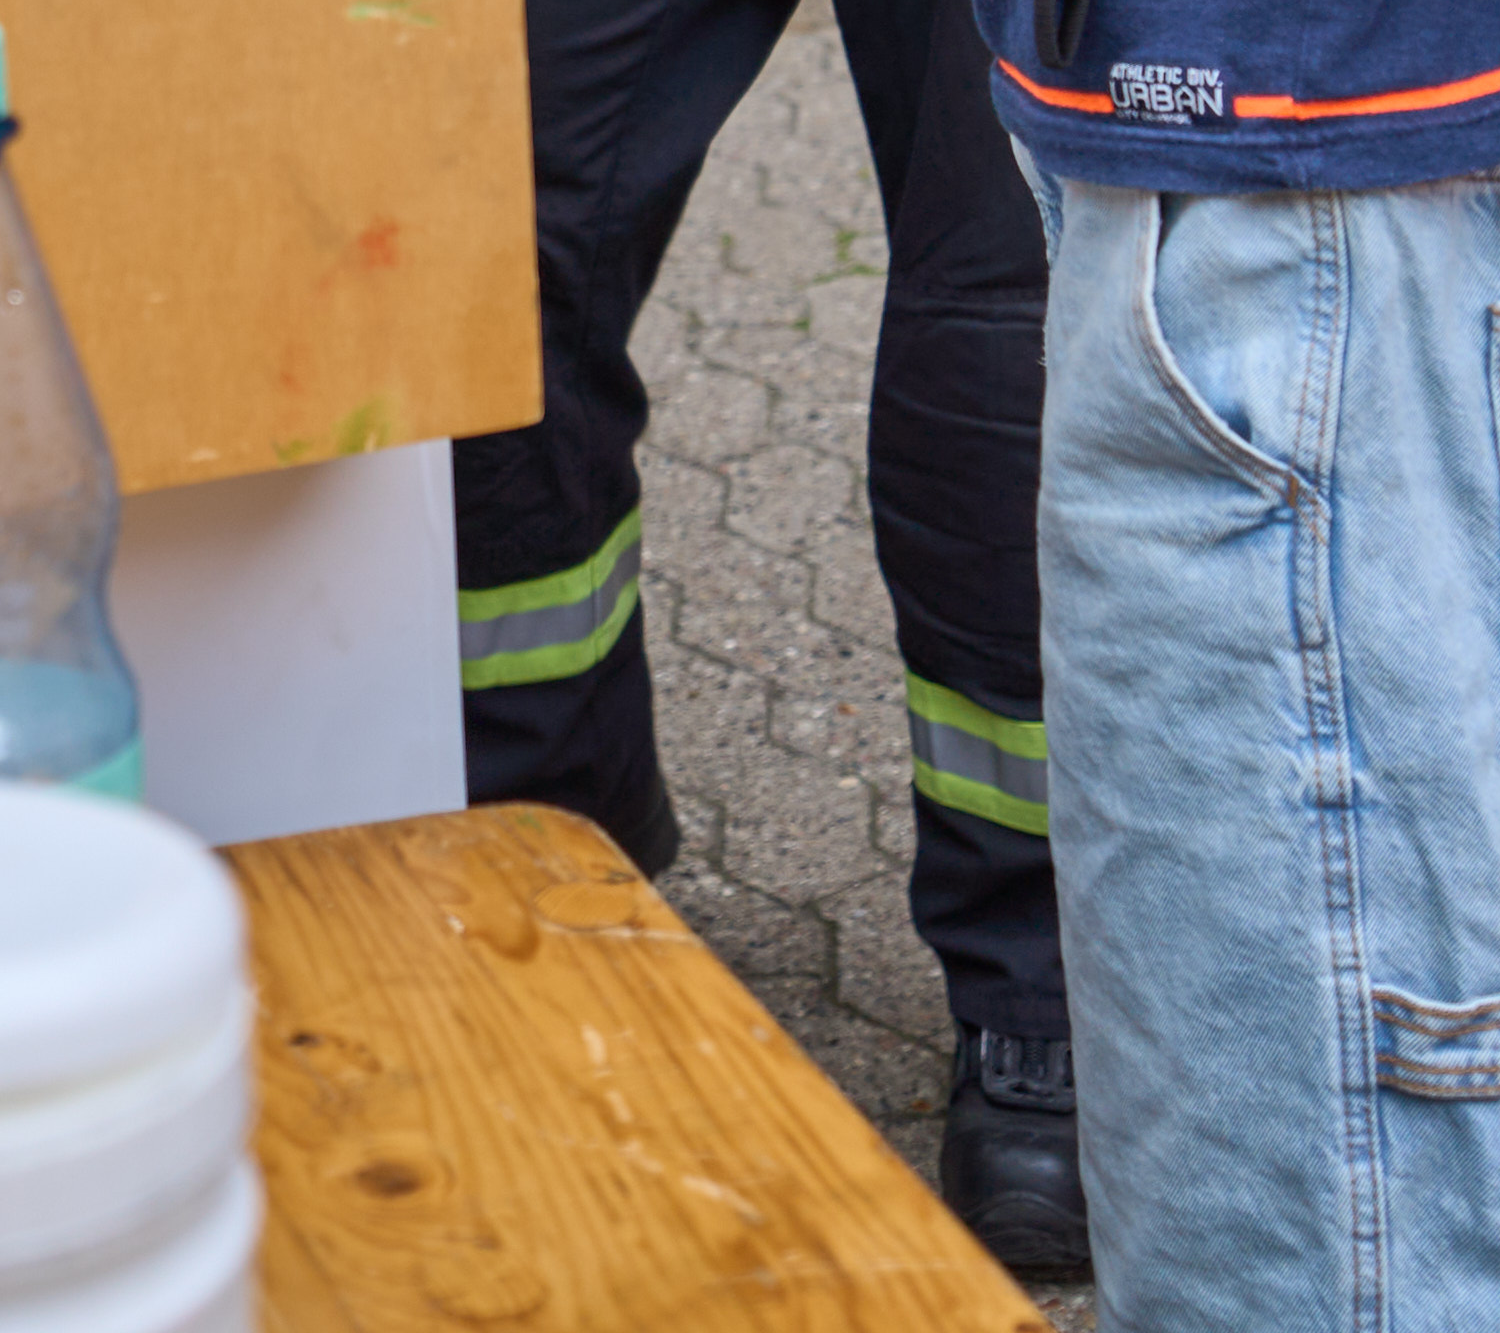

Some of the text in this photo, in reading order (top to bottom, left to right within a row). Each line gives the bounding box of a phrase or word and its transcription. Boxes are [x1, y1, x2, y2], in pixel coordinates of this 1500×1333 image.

[1109, 63, 1225, 88] ATHLETIC DIV.
[1108, 79, 1224, 117] URBAN
